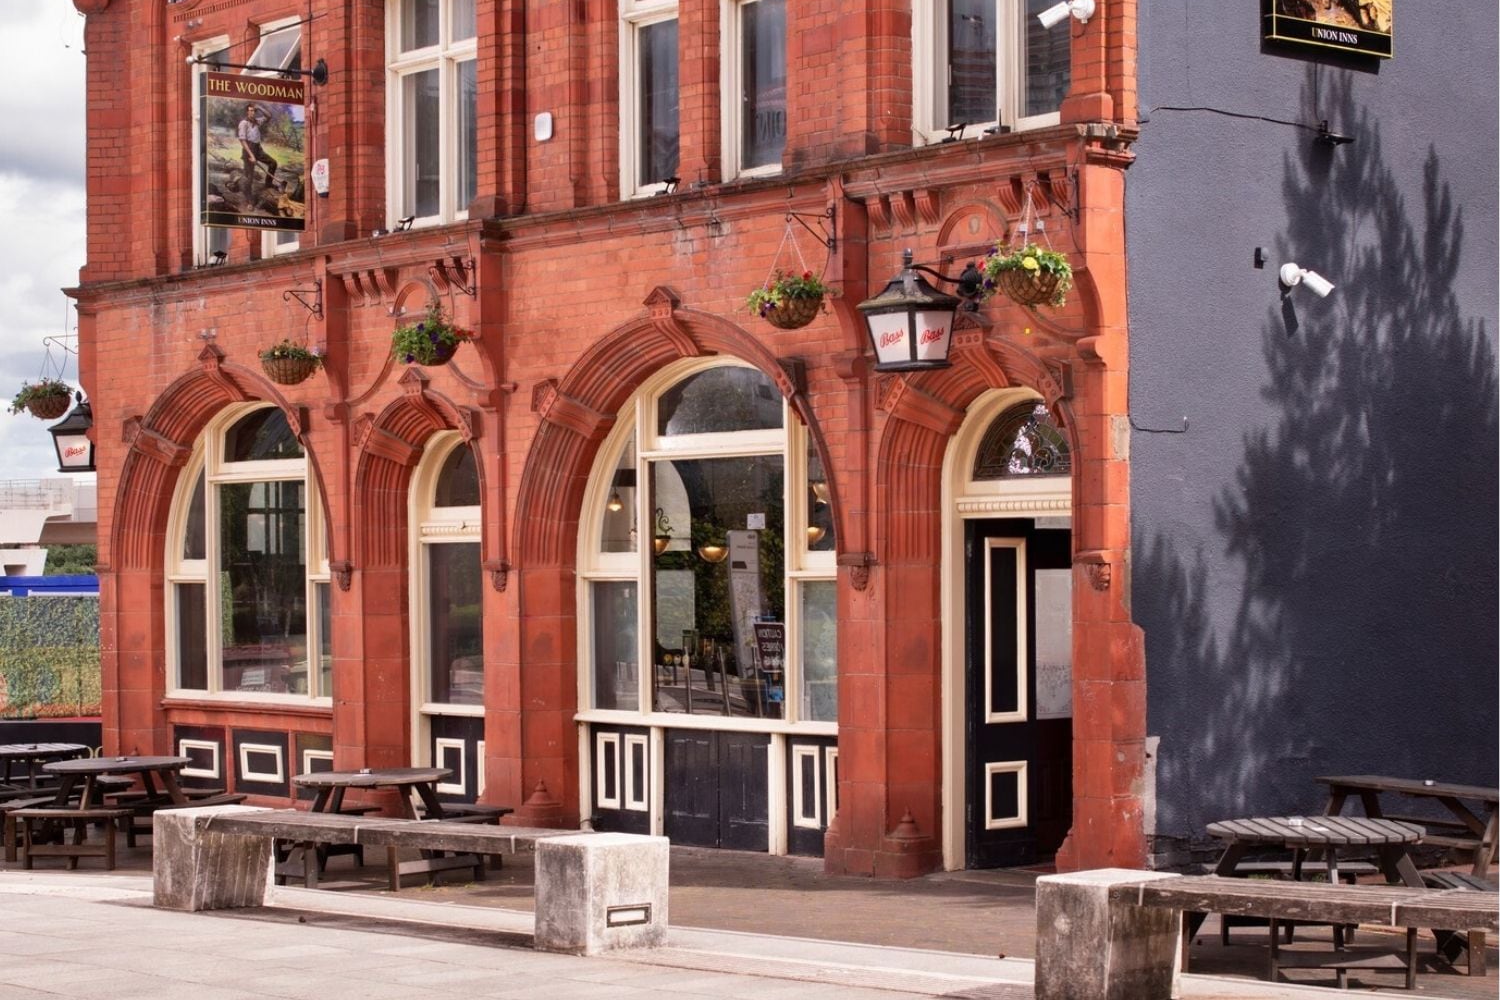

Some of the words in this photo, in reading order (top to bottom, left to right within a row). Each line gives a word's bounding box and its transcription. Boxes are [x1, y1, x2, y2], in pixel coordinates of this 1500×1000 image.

[1311, 27, 1338, 41] UNION
[1338, 31, 1358, 45] INNS
[208, 78, 231, 92] THE
[235, 81, 304, 99] WOODMAN
[237, 215, 260, 225] UNION
[880, 328, 904, 348] Bass
[920, 326, 945, 345] Bass
